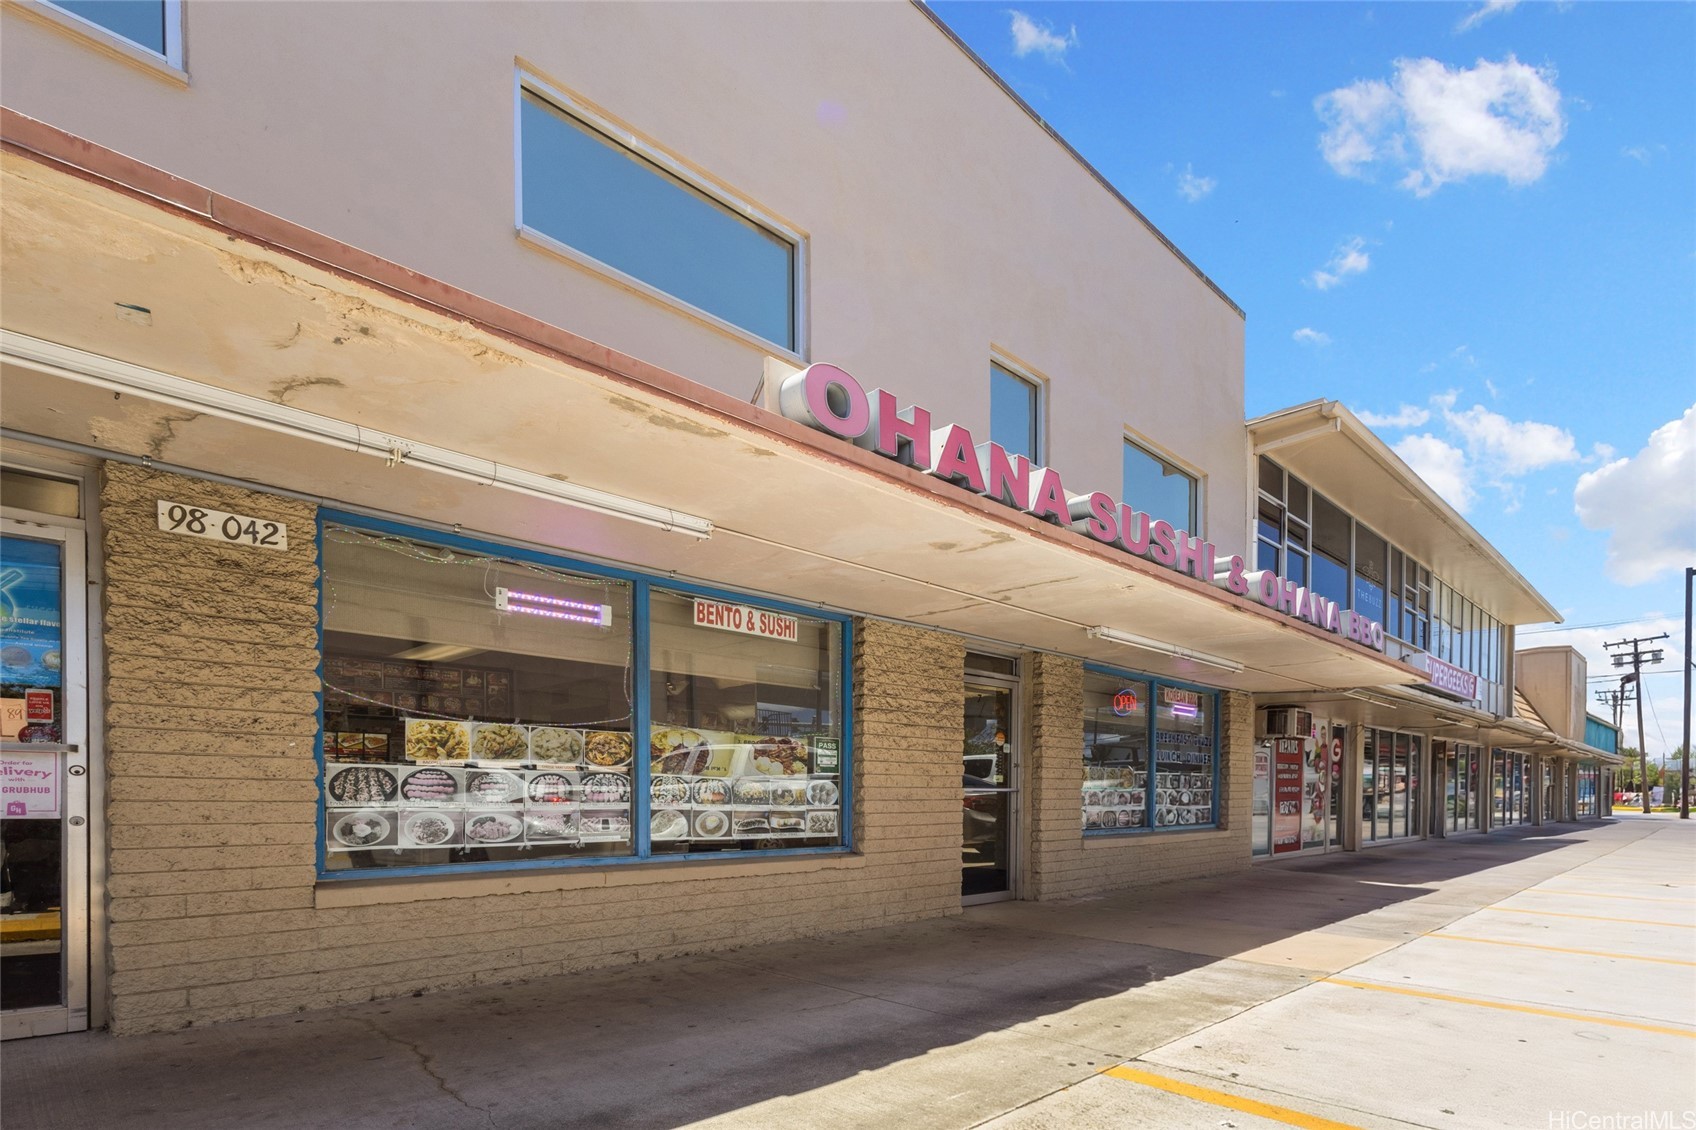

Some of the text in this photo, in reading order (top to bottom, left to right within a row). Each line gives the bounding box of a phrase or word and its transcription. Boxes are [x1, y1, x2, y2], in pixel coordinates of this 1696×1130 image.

[803, 362, 1384, 651] OHANA SUSHI & OHANA BBQ
[696, 601, 796, 639] BENTO & SUSHI
[1113, 694, 1137, 711] OPEN
[818, 742, 837, 750] PASS
[1, 786, 51, 794] GRUBHUB
